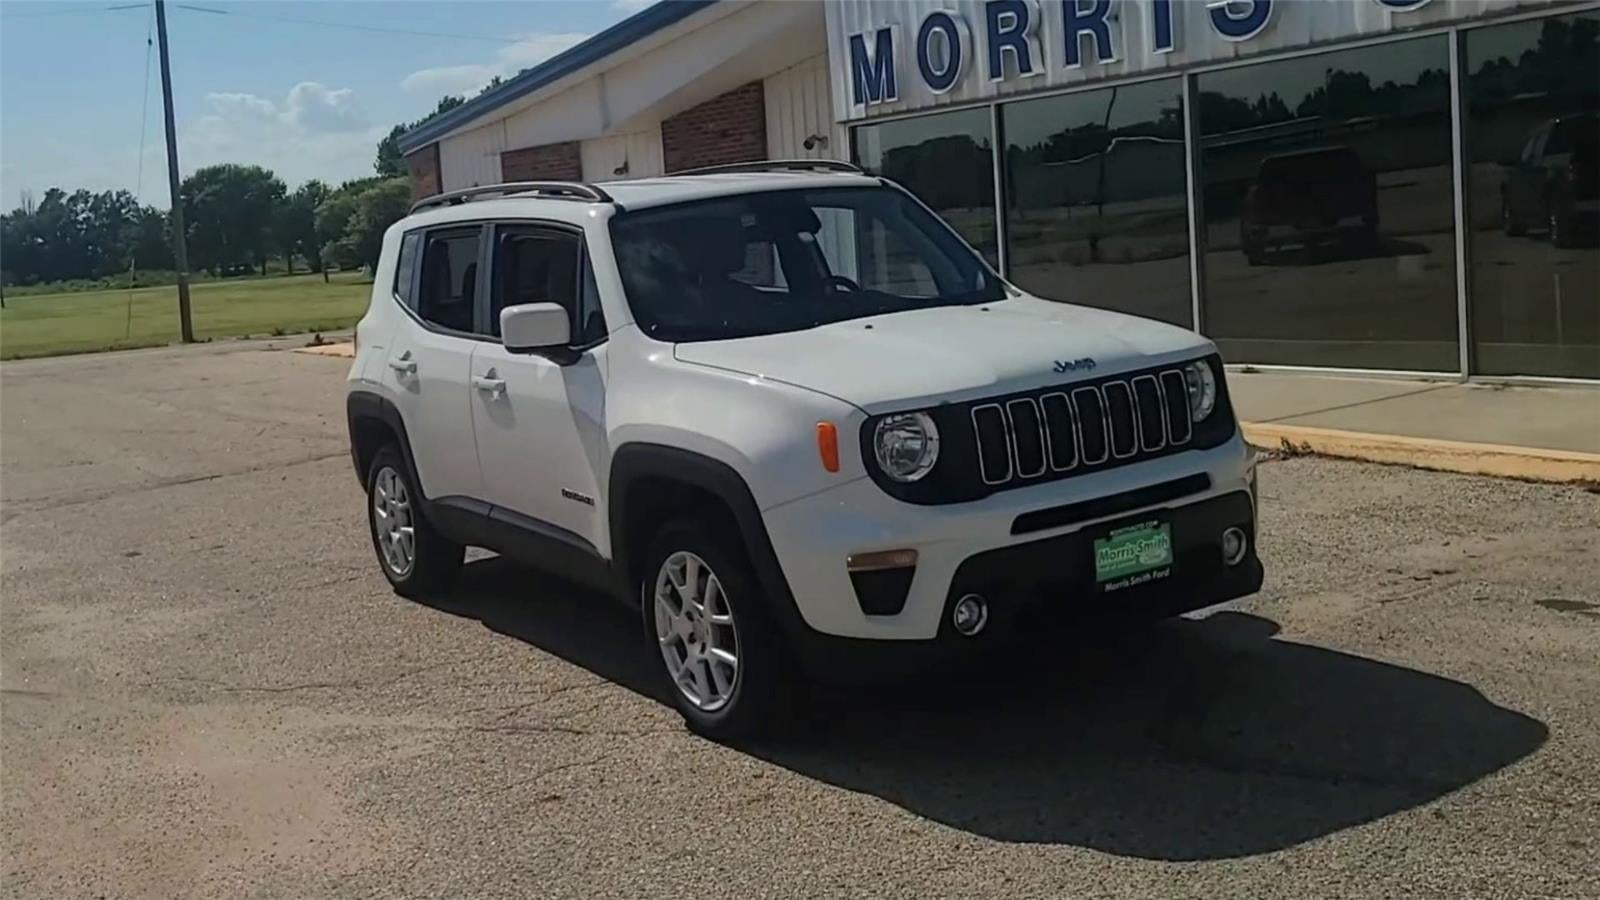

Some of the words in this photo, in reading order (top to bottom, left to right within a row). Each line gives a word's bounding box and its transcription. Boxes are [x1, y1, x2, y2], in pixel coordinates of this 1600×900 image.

[1053, 357, 1096, 373] Jeep
[1099, 543, 1136, 563] Morris
[1136, 533, 1169, 554] Smith
[1152, 567, 1170, 580] Ford
